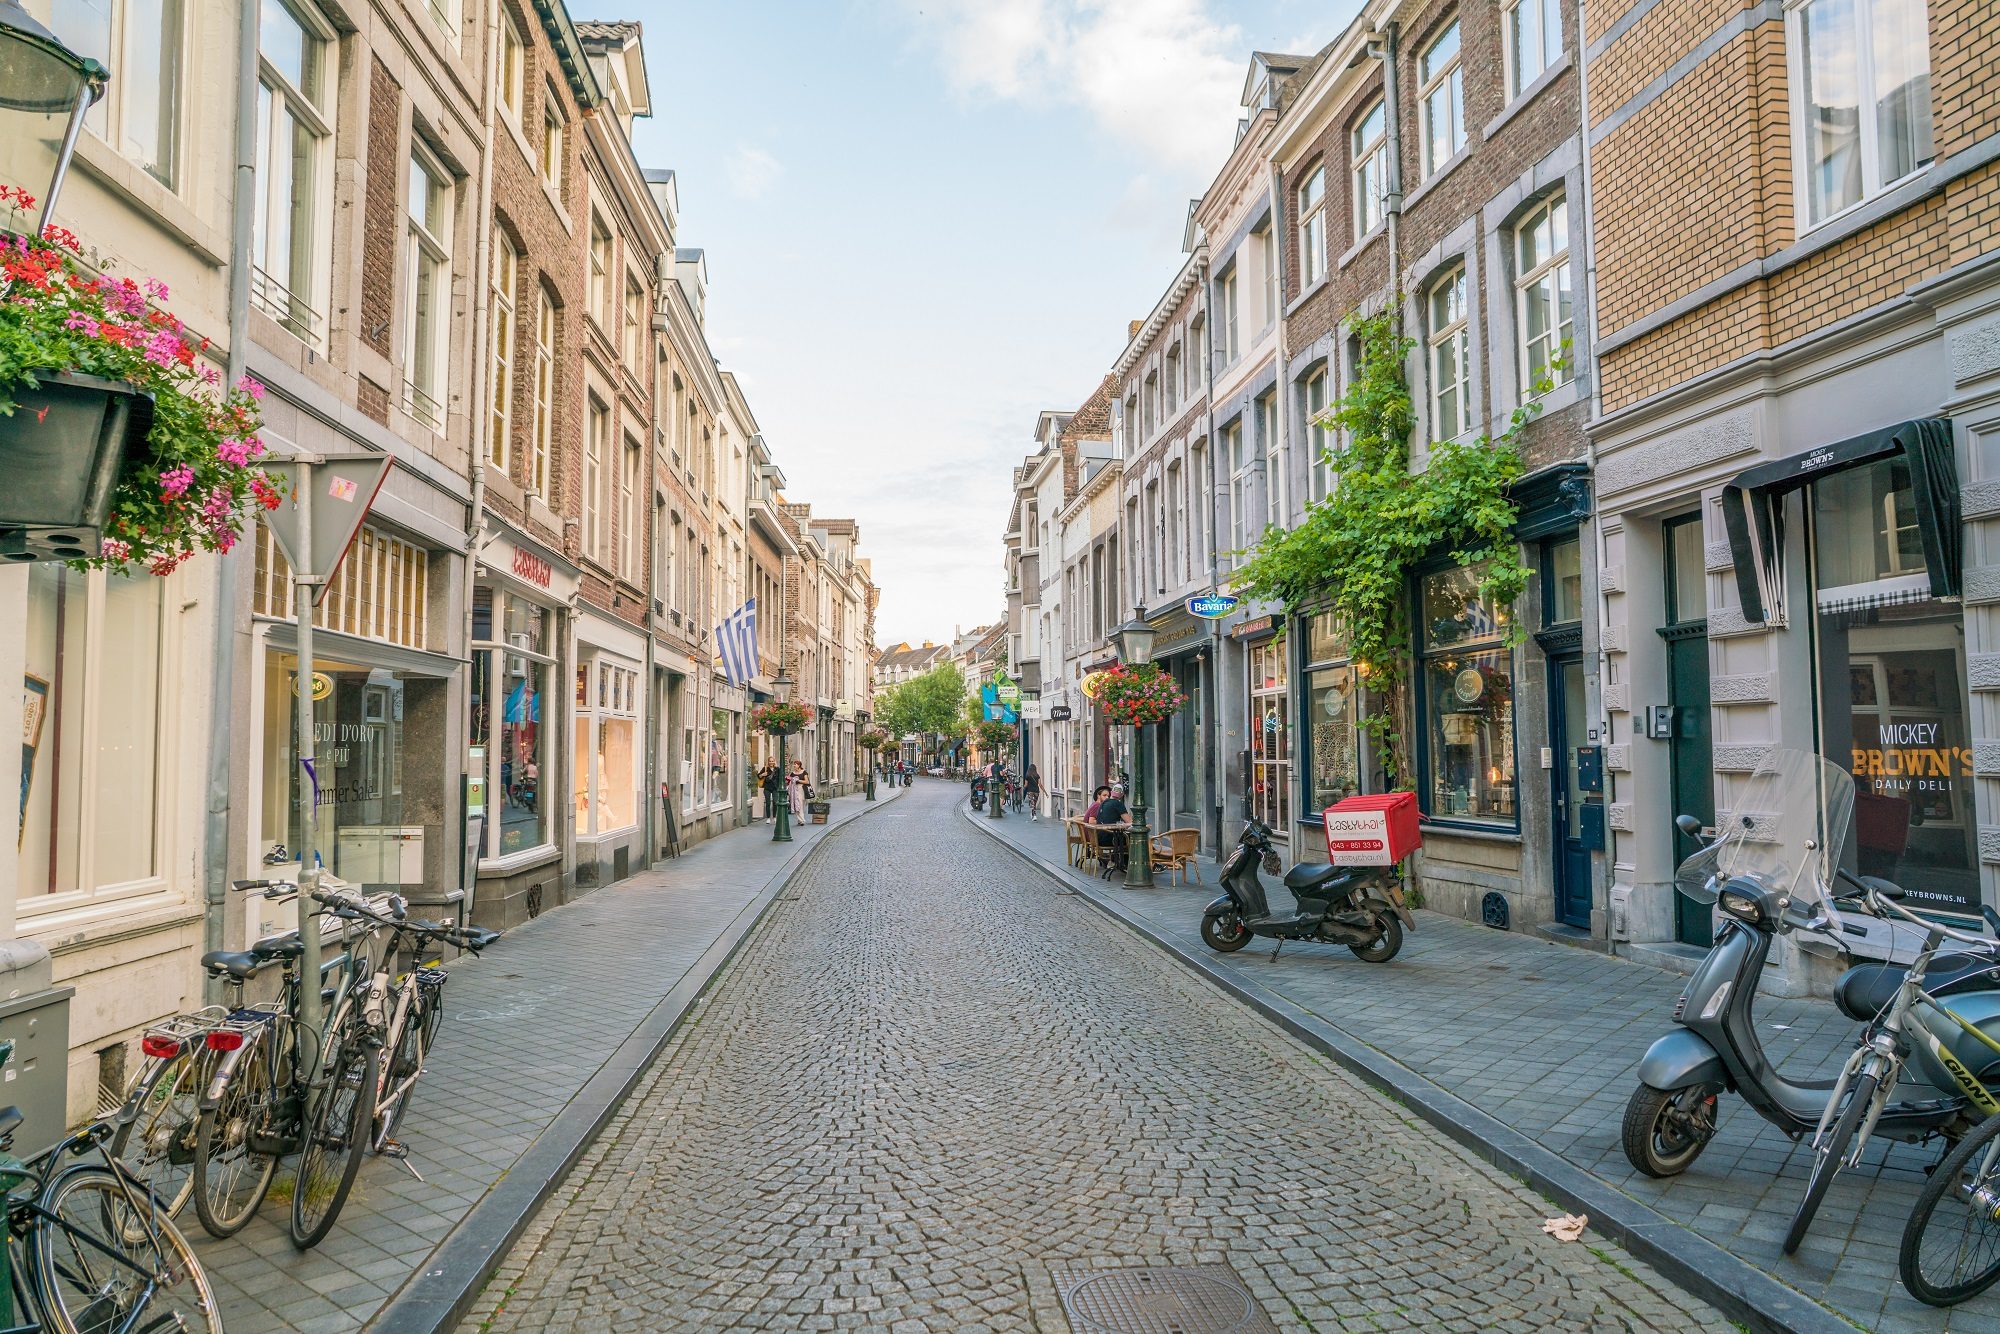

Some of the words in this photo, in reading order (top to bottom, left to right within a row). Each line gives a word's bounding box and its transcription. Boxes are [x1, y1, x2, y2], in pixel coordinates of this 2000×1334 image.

[1801, 452, 1834, 469] BROWN'S
[1194, 601, 1233, 612] Bavaria
[341, 724, 374, 743] D'ORO
[1879, 723, 1938, 745] MICKEY
[1851, 746, 1975, 777] BROWN'S
[352, 779, 374, 802] Sale
[1875, 779, 1912, 790] DAILY
[1919, 780, 1952, 791] DELI
[1372, 841, 1382, 849] 94
[1944, 1058, 1997, 1107] GIANT
